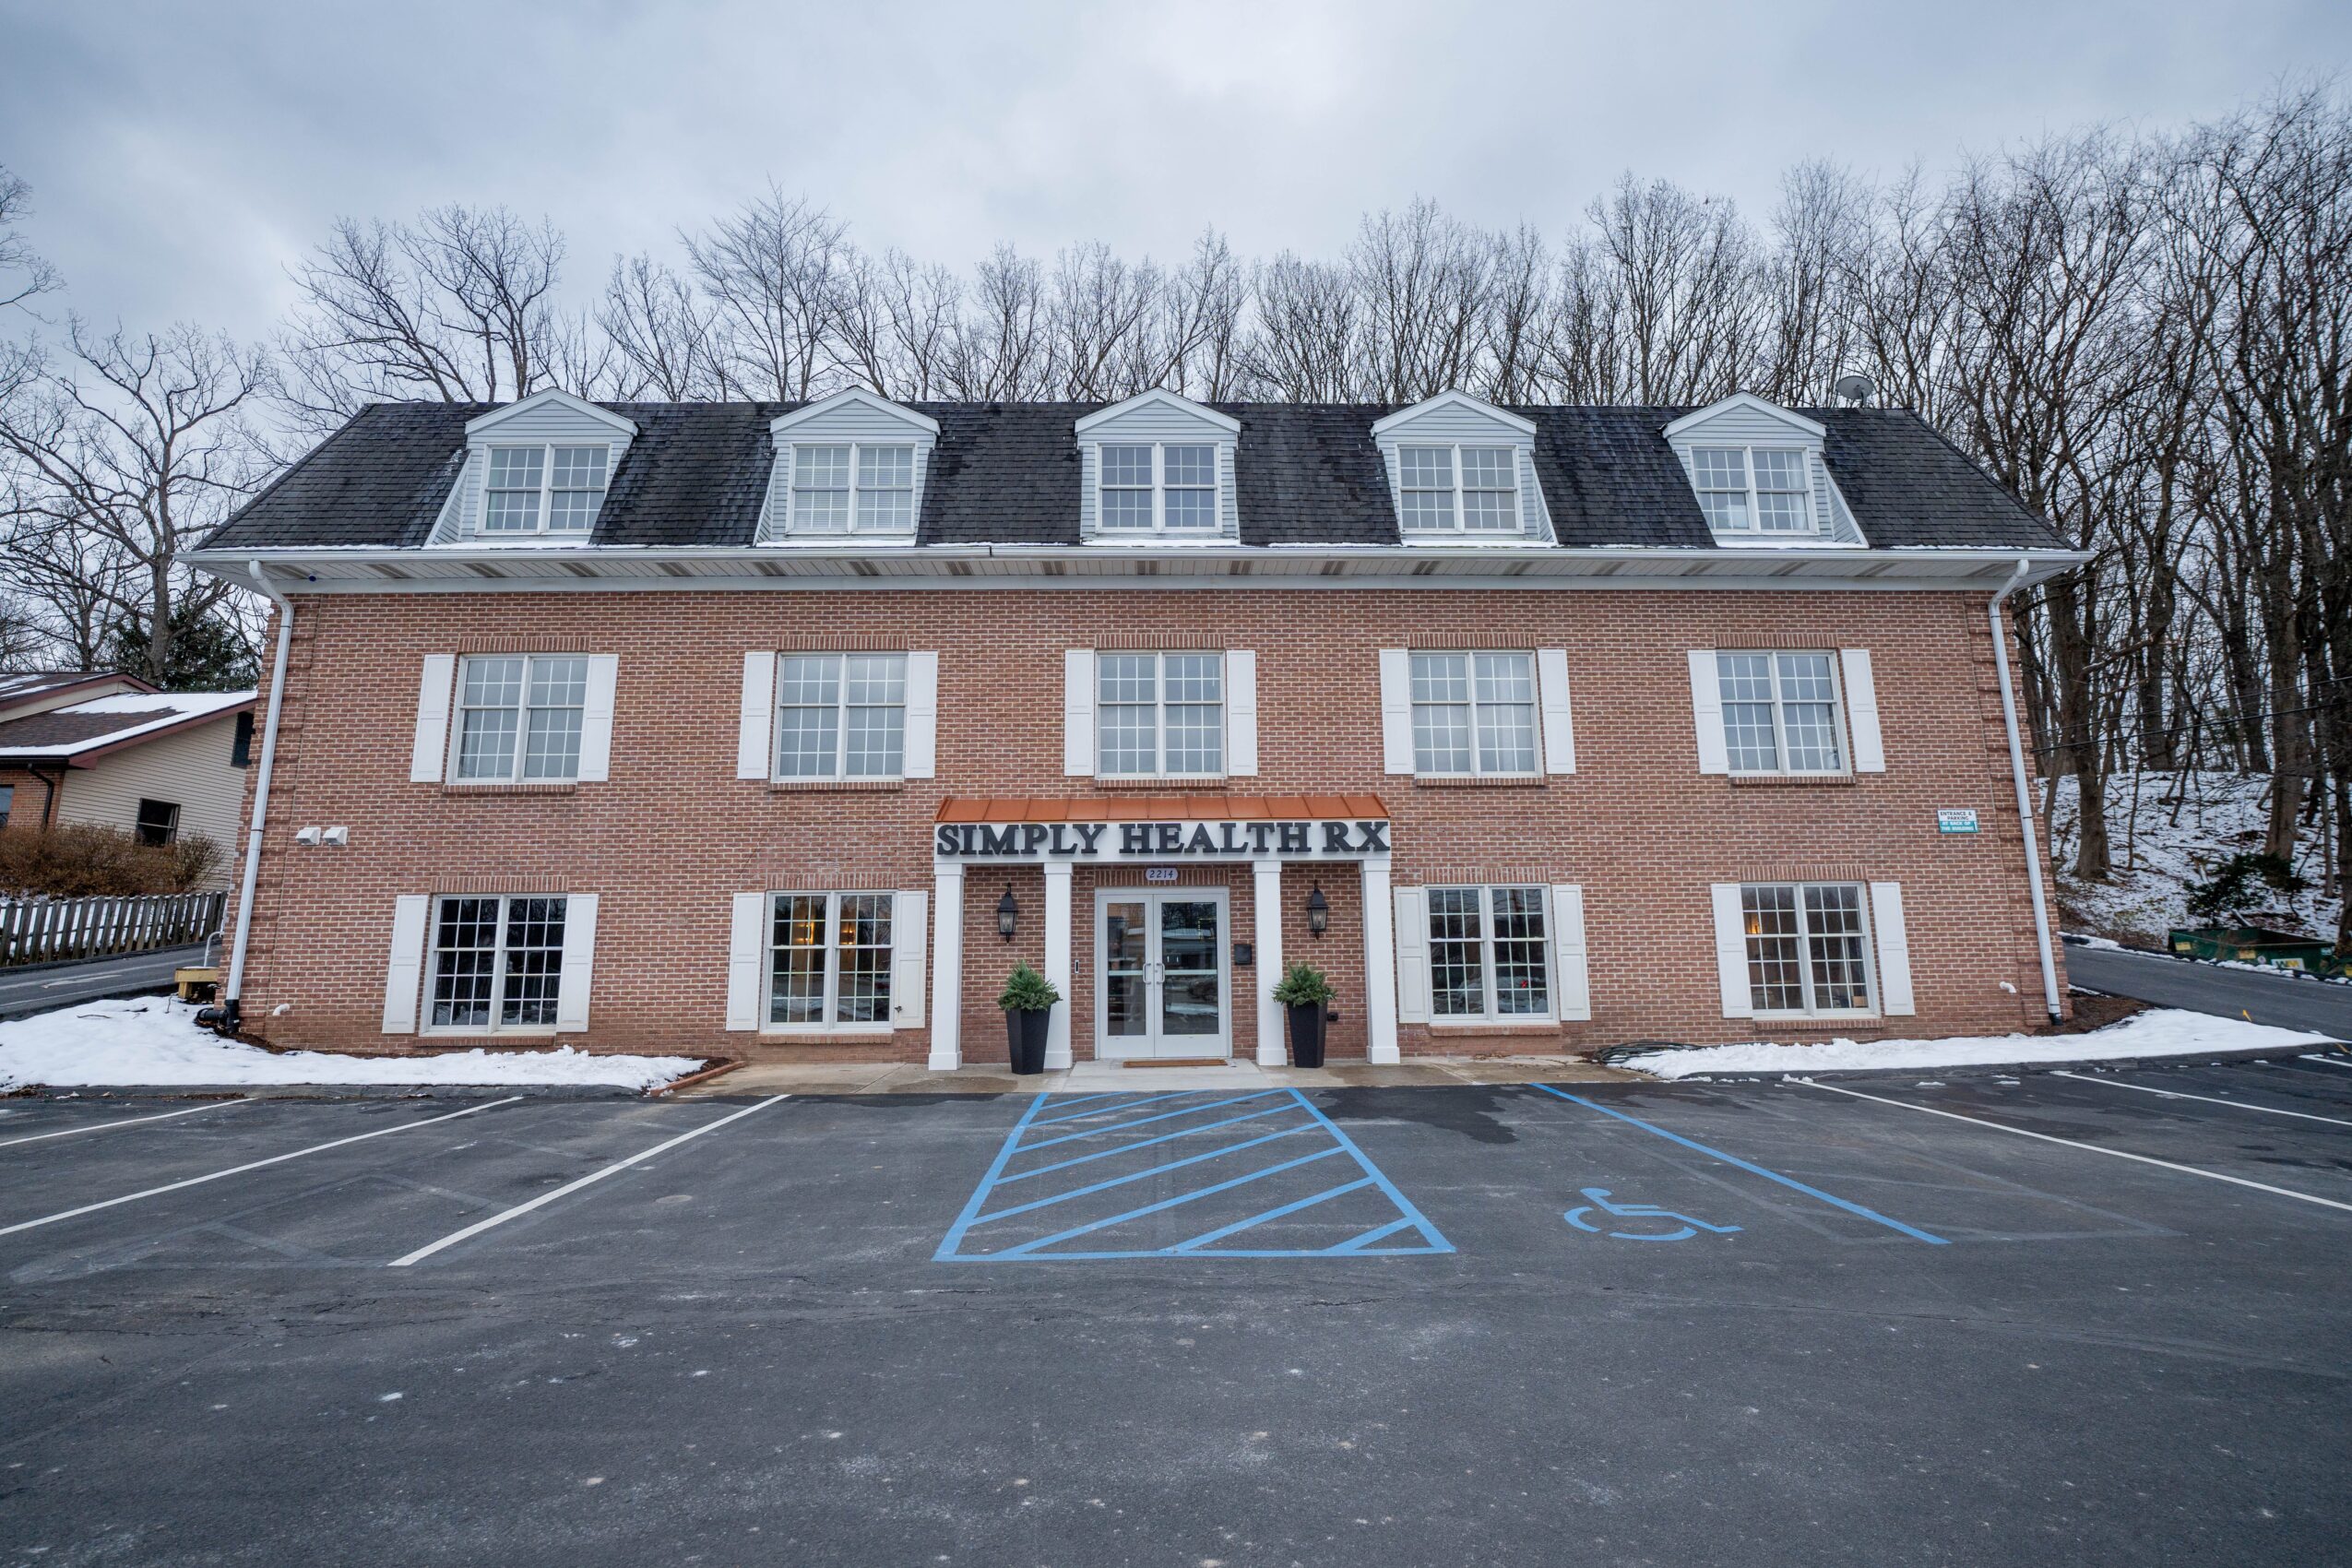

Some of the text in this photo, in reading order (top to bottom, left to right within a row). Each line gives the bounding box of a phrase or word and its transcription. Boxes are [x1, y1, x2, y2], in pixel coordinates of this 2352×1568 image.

[937, 821, 1391, 856] SIMPLY HEALTH RX
[1149, 870, 1173, 879] 2214
[2275, 960, 2300, 968] WM
